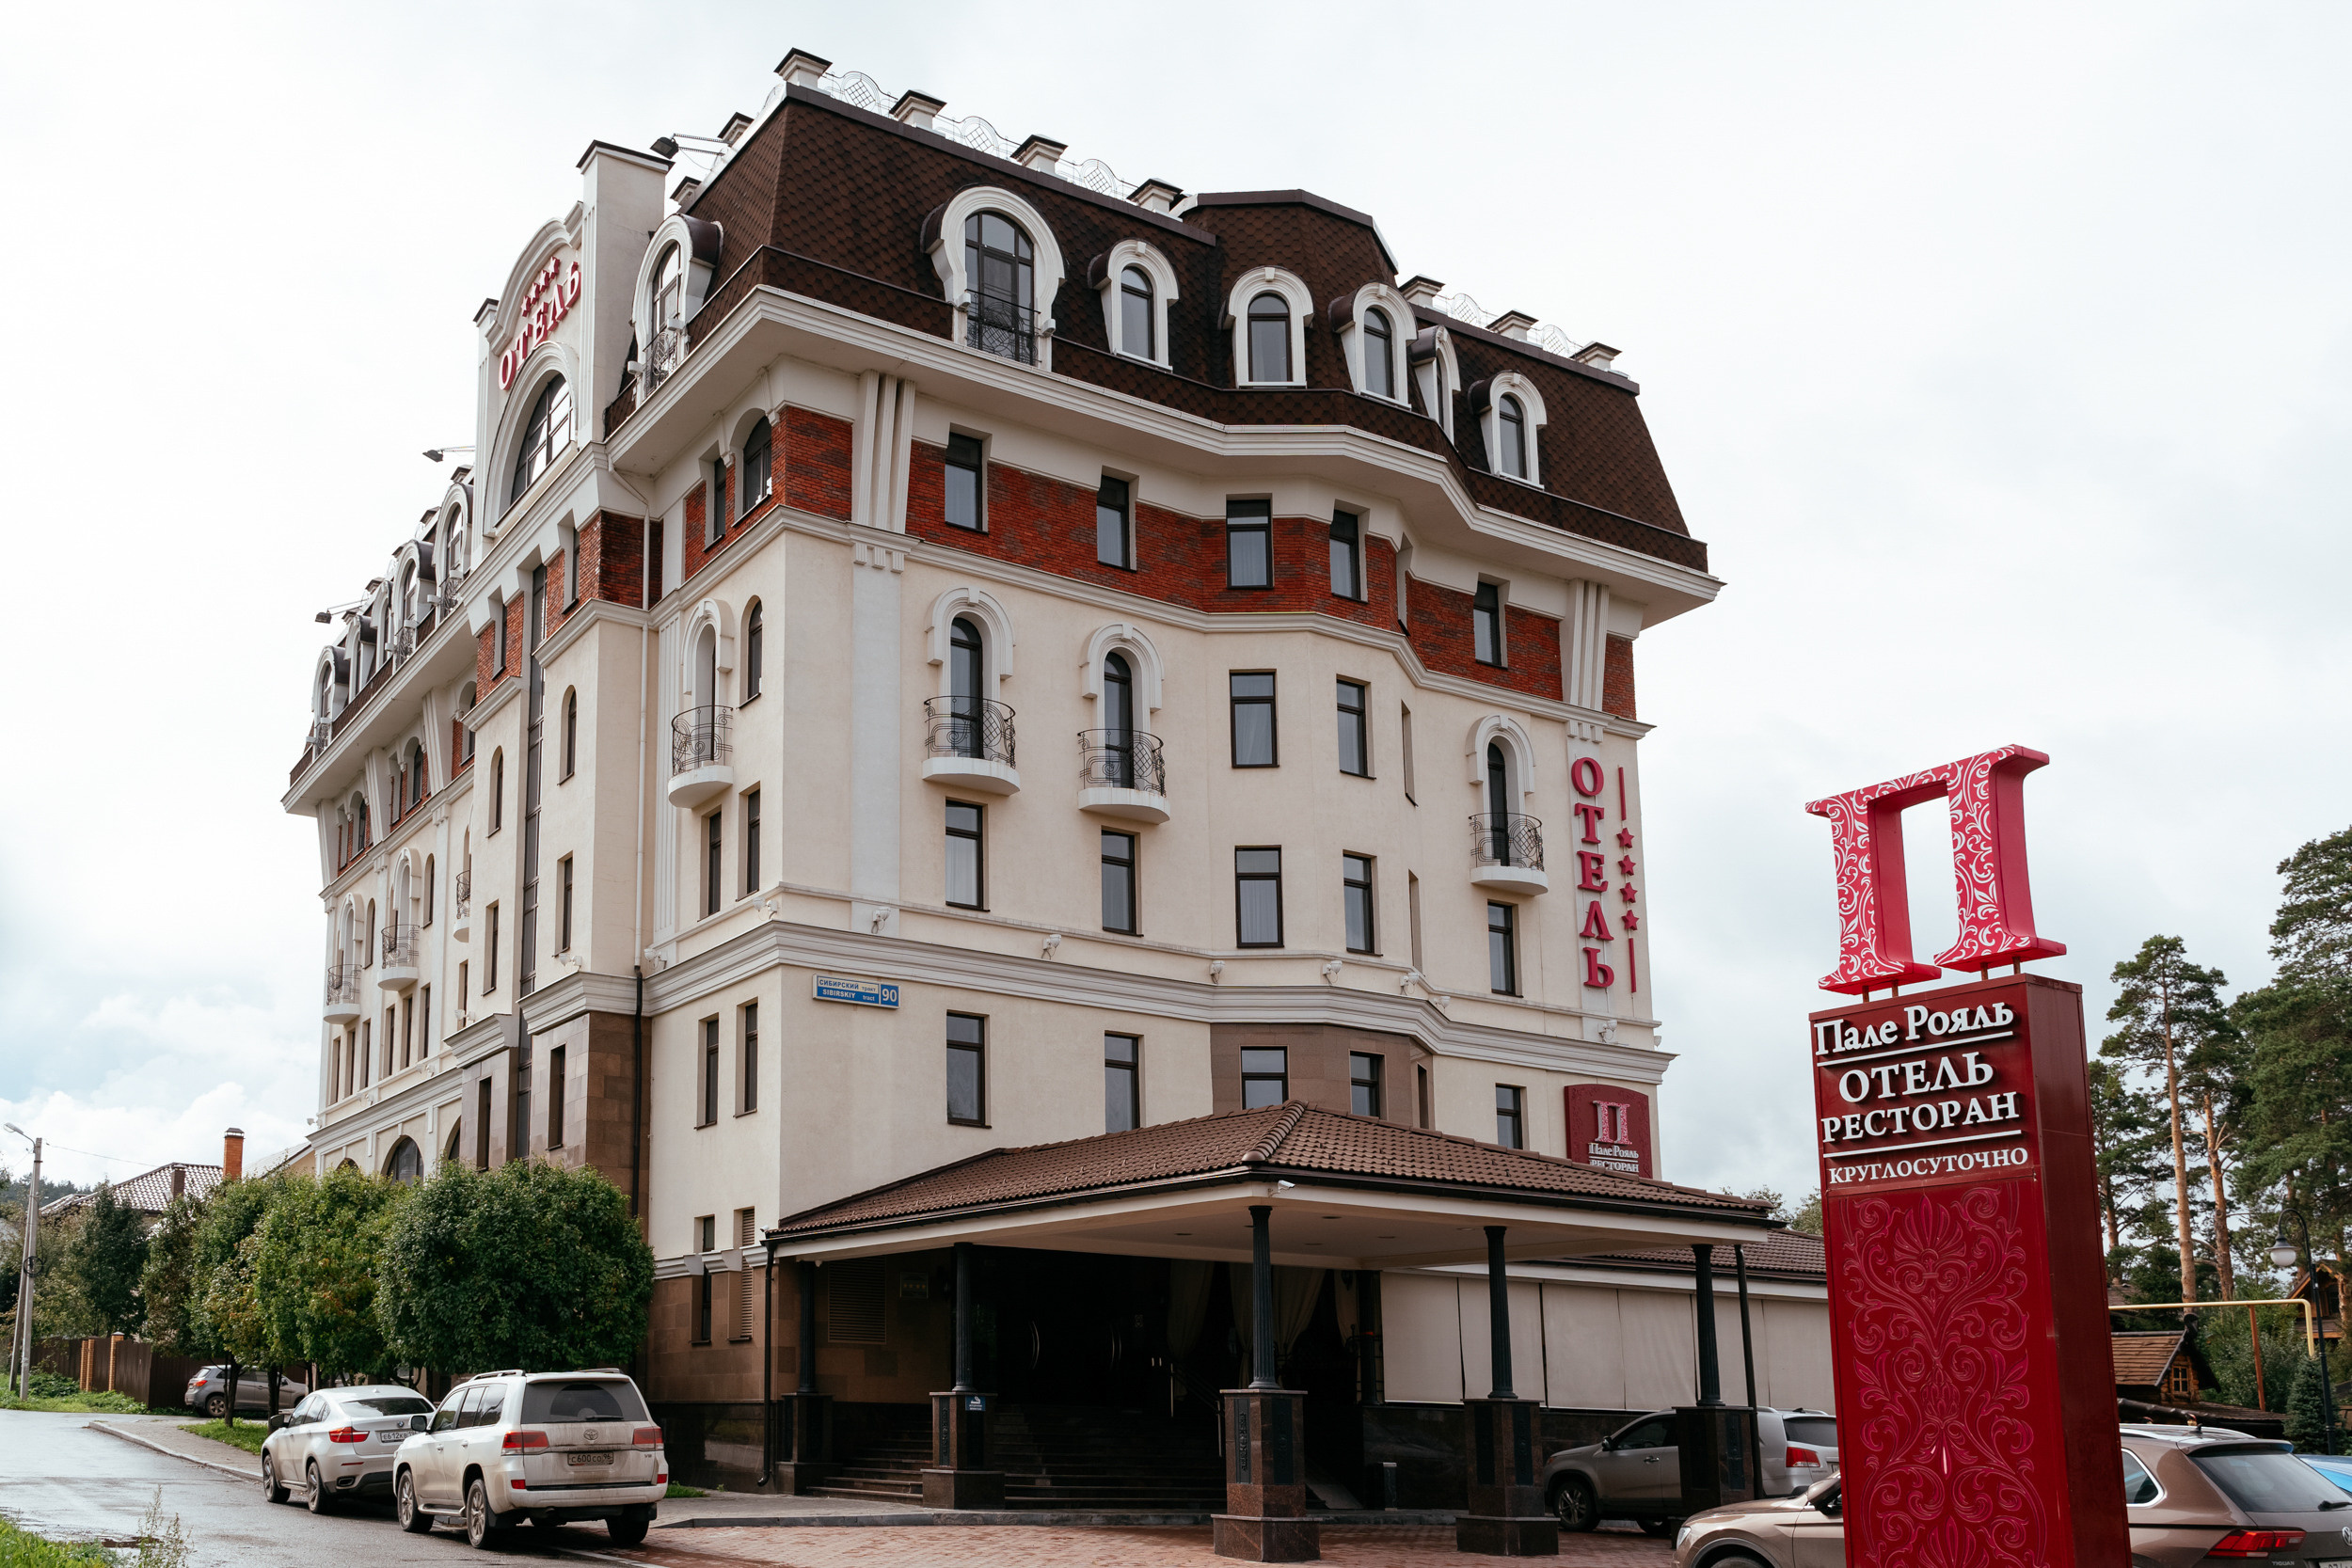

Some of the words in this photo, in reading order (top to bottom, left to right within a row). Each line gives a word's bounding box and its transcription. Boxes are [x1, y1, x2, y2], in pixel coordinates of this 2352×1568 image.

[499, 261, 581, 390] ОТЕЛЬ
[1571, 756, 1615, 989] ОТЕЛЬ
[818, 979, 859, 990] СИБИРСКИЙ
[882, 989, 898, 1003] 90
[822, 989, 856, 999] SIBIRSKIY
[1814, 1019, 1898, 1055] Пале
[1904, 1002, 2014, 1041] Рояль
[1838, 1052, 1994, 1103] ОТЕЛЬ
[1820, 1091, 2020, 1143] РЕСТОРАН
[1588, 1142, 1613, 1156] Пале
[1612, 1145, 1639, 1159] Рояль
[1828, 1147, 2028, 1184] КРУГЛОСУТОЧНО
